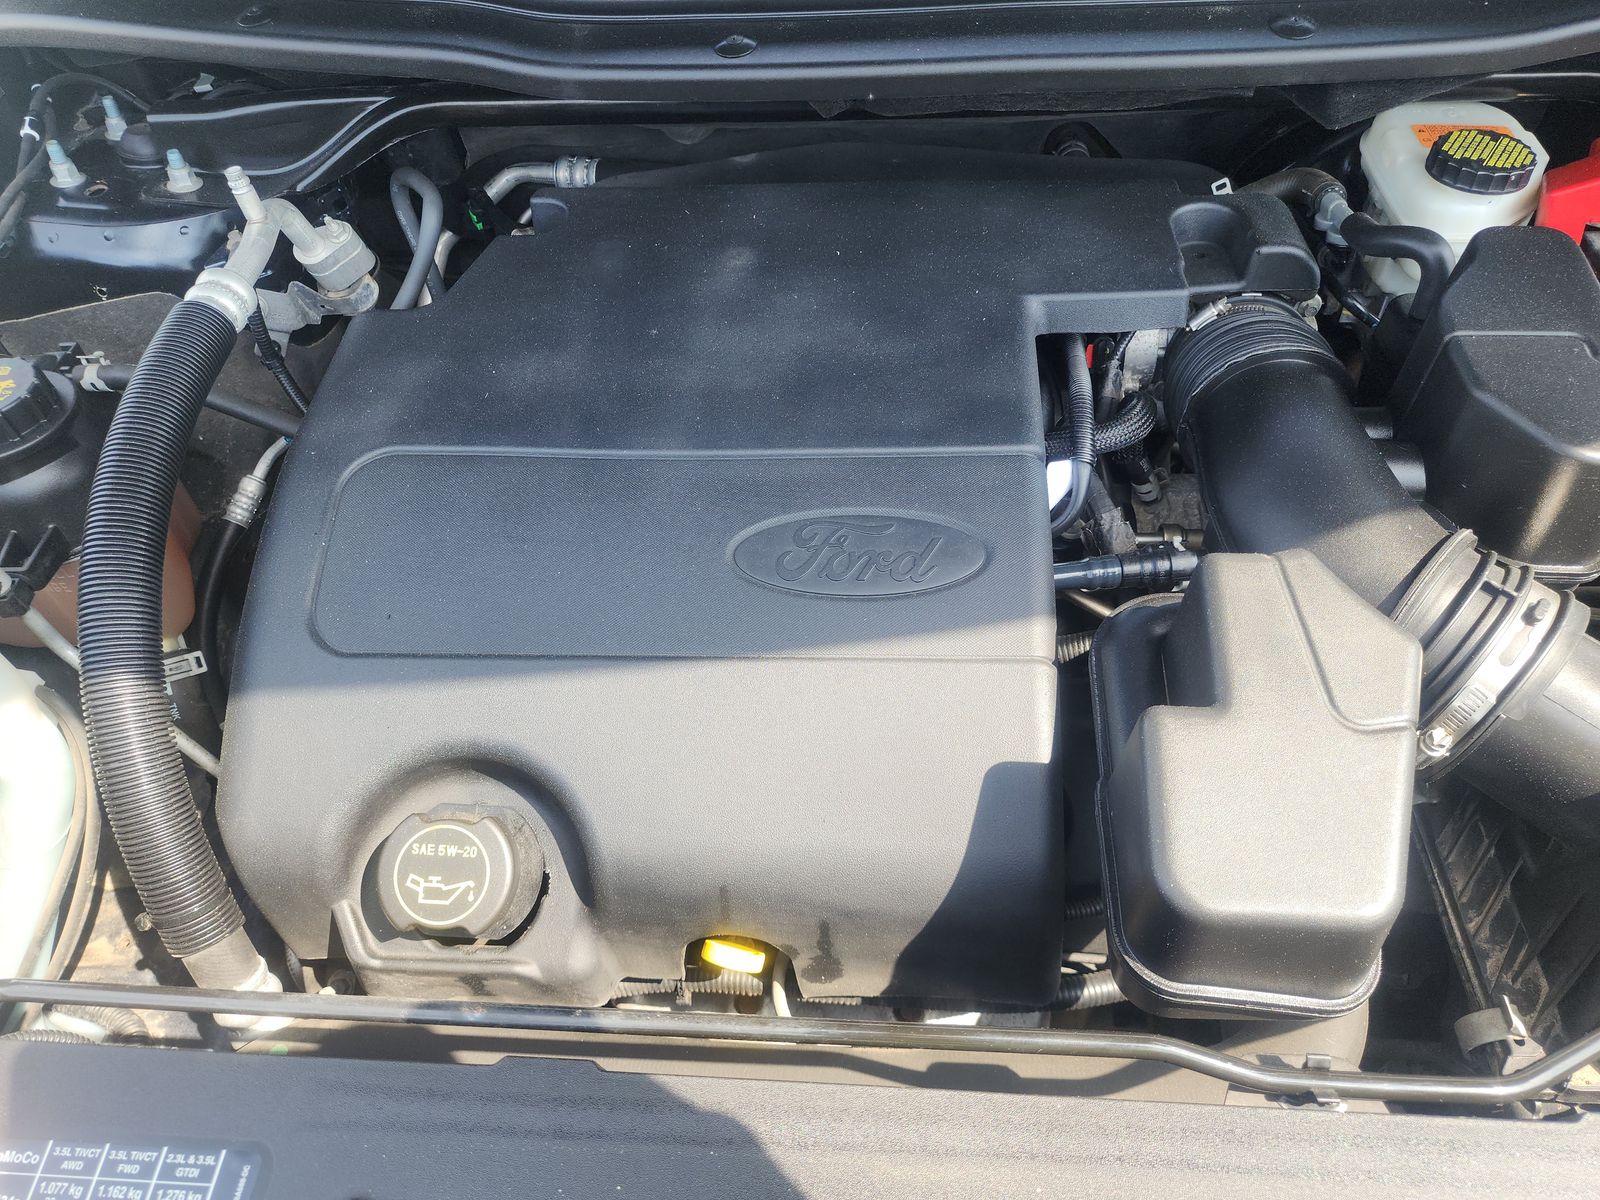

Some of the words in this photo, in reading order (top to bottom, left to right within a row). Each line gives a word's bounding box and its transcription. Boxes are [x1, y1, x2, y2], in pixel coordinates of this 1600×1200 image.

[775, 520, 943, 583] Ford
[411, 843, 435, 856] SAE
[437, 844, 478, 858] 5W-20
[61, 1161, 84, 1171] AWD
[117, 1163, 140, 1175] FWD
[40, 1181, 68, 1195] 1.077
[68, 1184, 83, 1199] kg
[98, 1185, 127, 1199] 1.162
